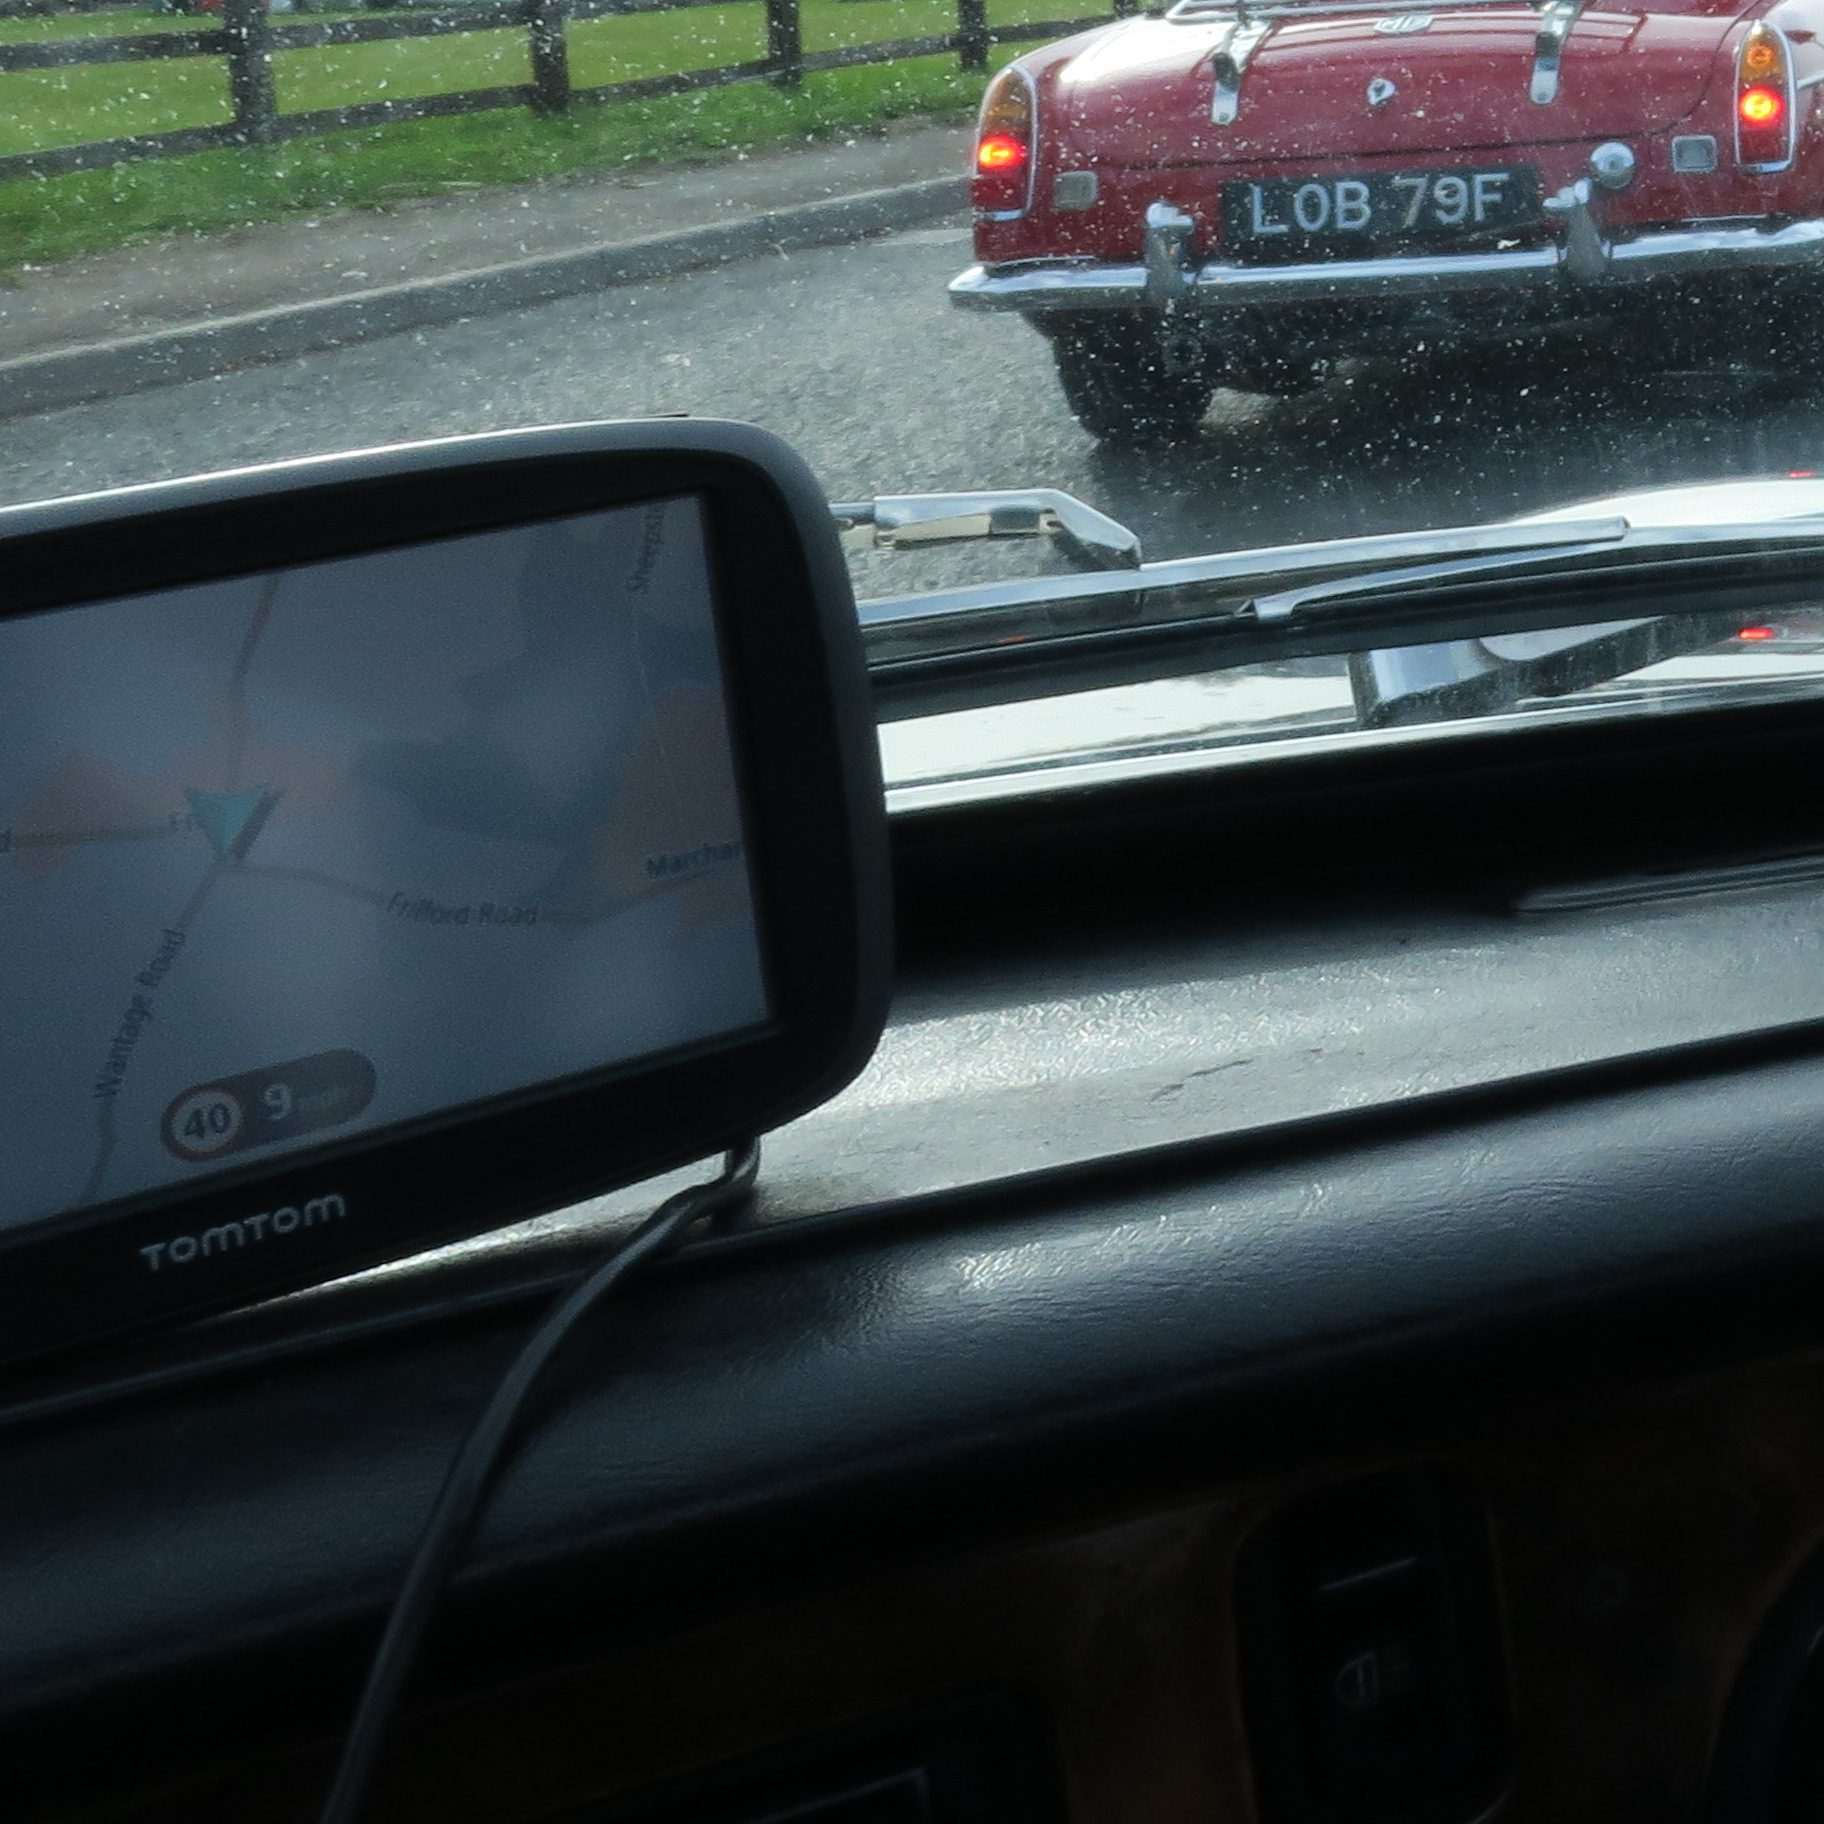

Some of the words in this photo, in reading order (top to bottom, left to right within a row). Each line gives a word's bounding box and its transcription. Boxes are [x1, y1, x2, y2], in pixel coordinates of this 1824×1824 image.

[1247, 180, 1373, 234] LOB
[1390, 172, 1511, 229] 79F
[478, 900, 541, 926] Road
[94, 994, 153, 1099] Wantage
[134, 929, 186, 987] Road
[183, 1102, 231, 1139] 40
[263, 1082, 293, 1121] 9
